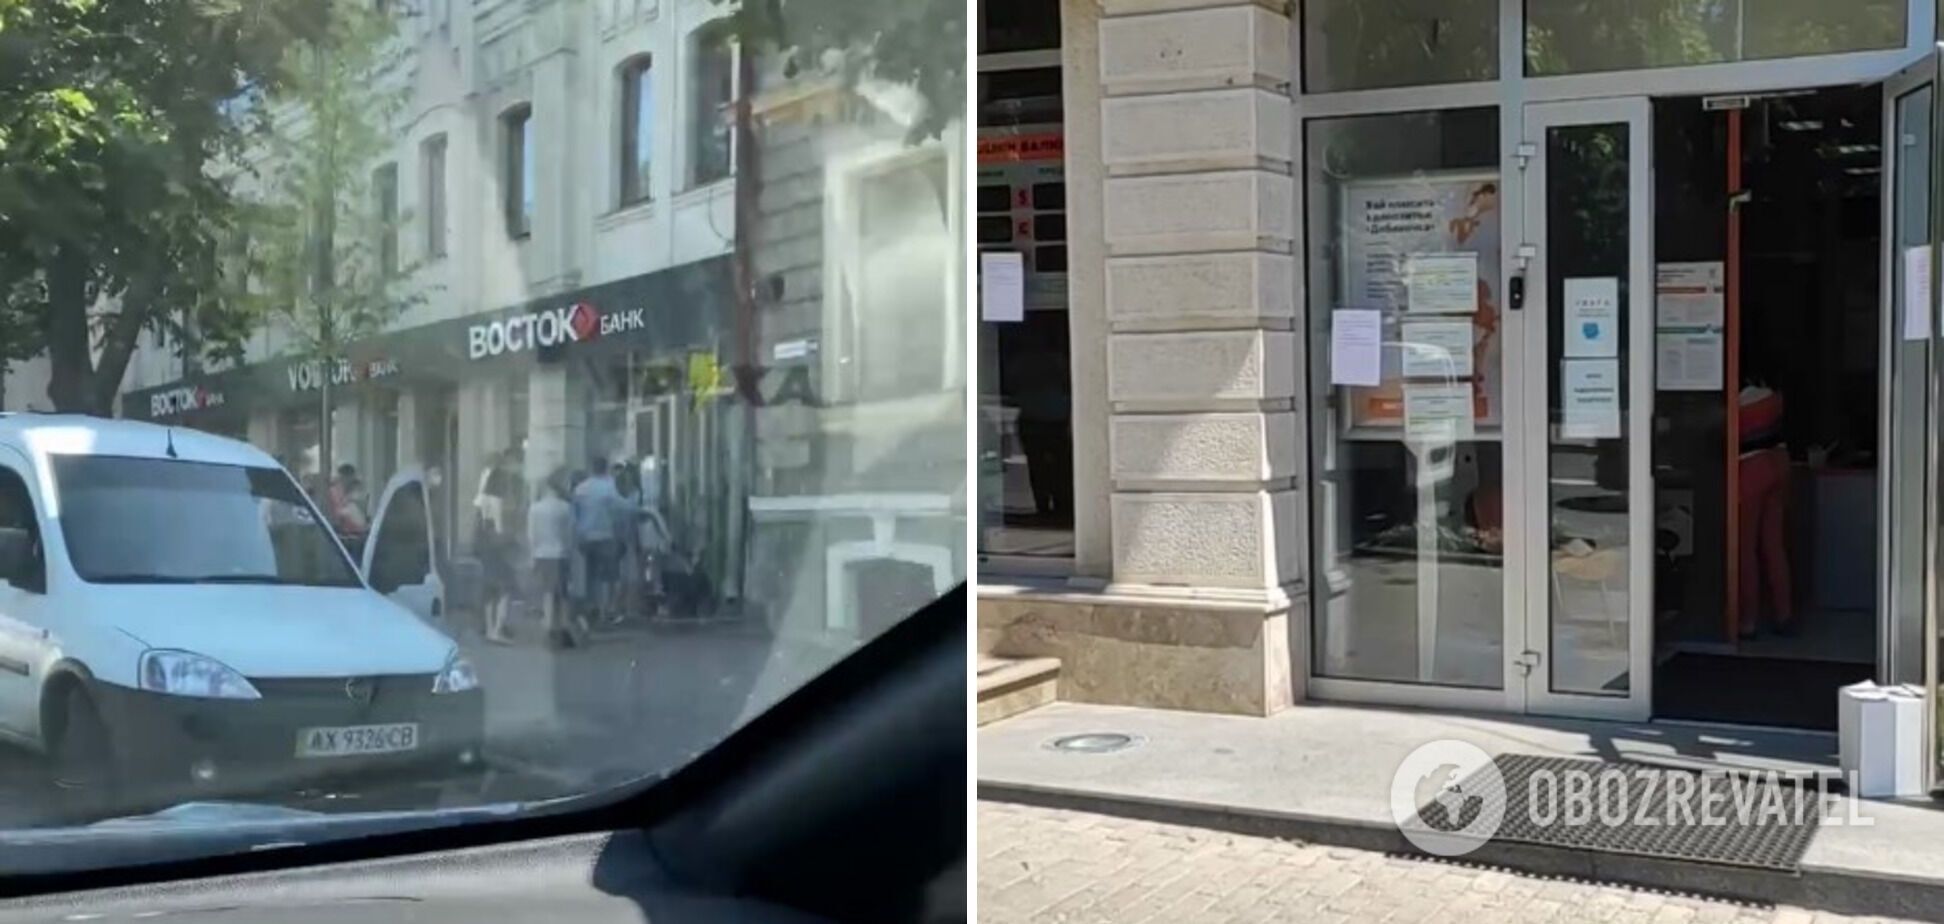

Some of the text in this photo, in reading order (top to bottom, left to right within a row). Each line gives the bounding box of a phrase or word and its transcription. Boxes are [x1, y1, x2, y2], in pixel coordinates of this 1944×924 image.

[469, 304, 645, 360] ВОСТОК БАНК
[151, 385, 199, 417] ВОСТОК
[387, 725, 414, 747] CB
